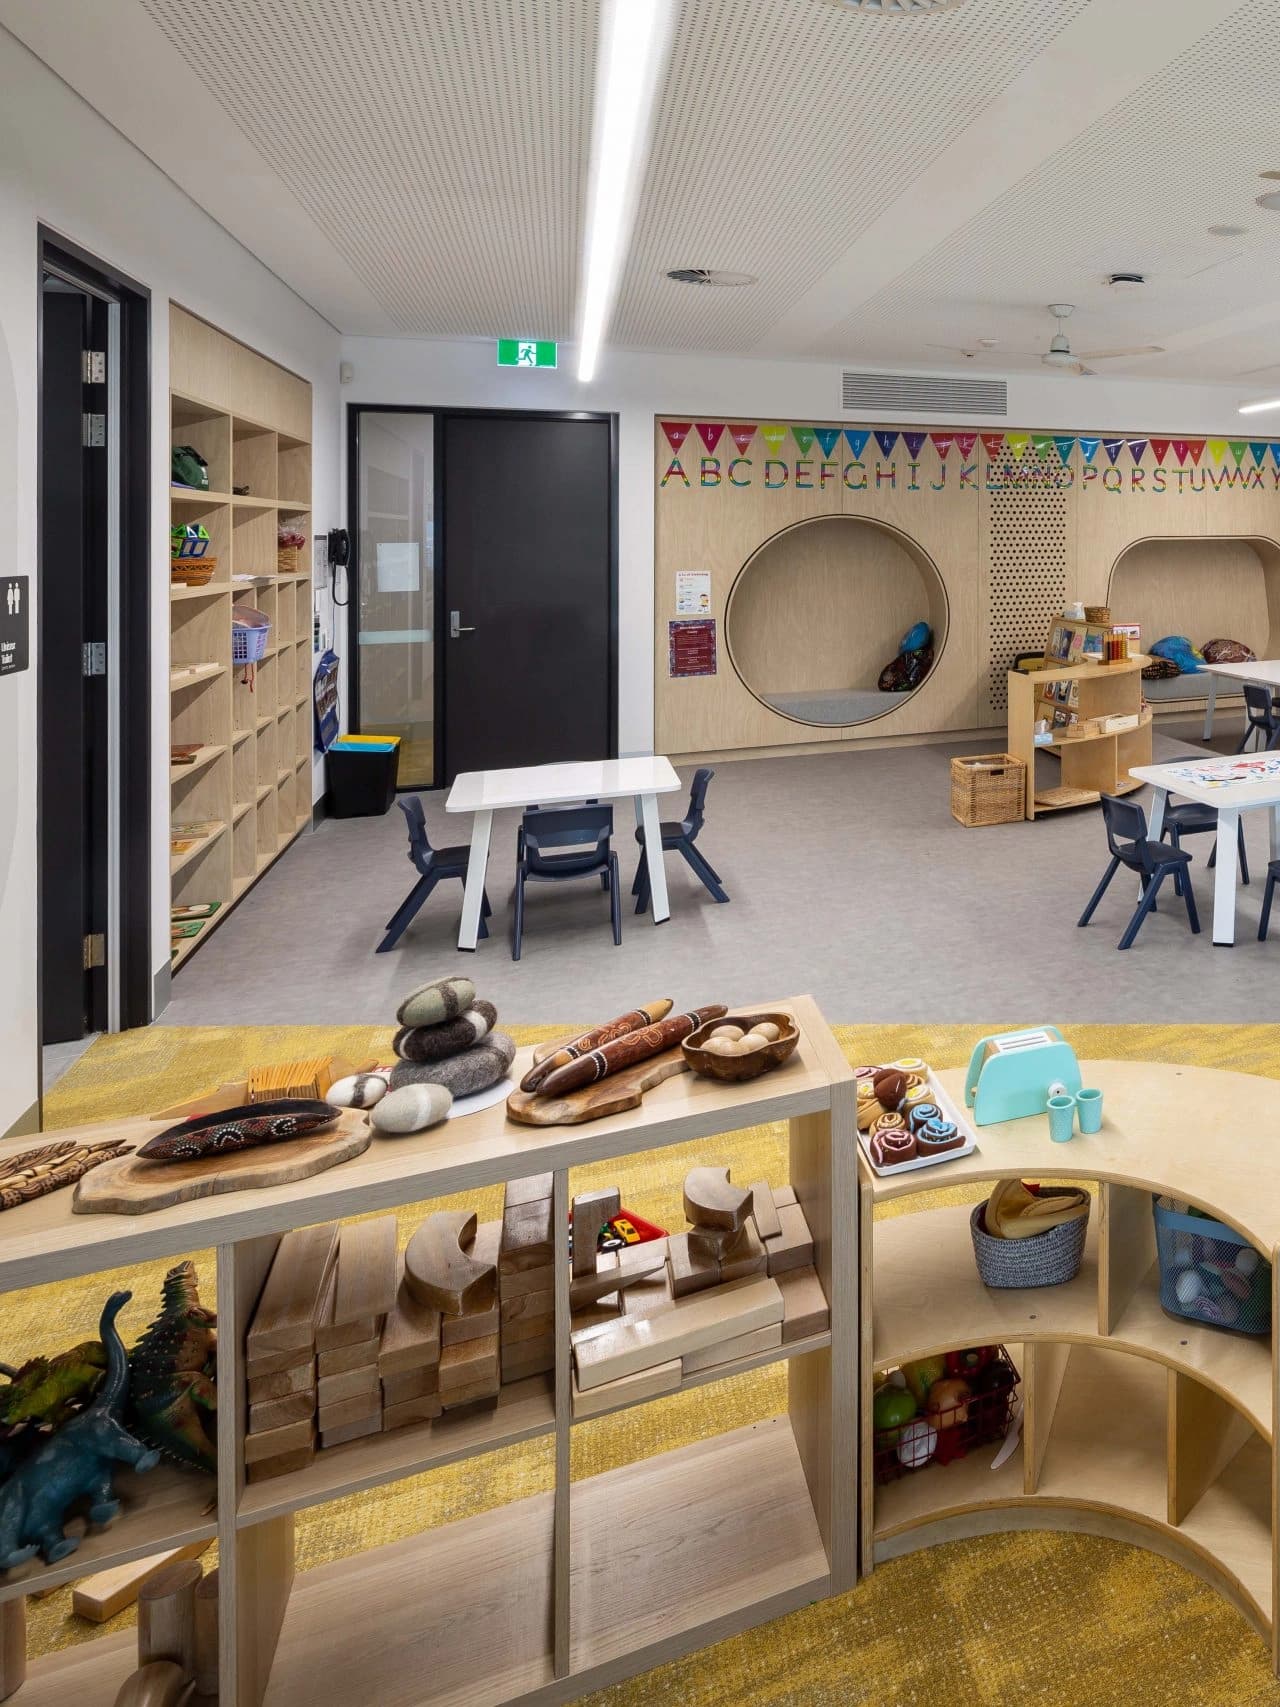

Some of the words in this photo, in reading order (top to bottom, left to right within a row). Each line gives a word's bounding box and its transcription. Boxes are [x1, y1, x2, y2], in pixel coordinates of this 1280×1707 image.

[707, 427, 714, 441] b
[824, 432, 832, 444] f
[854, 439, 860, 451] g
[883, 434, 890, 447] h
